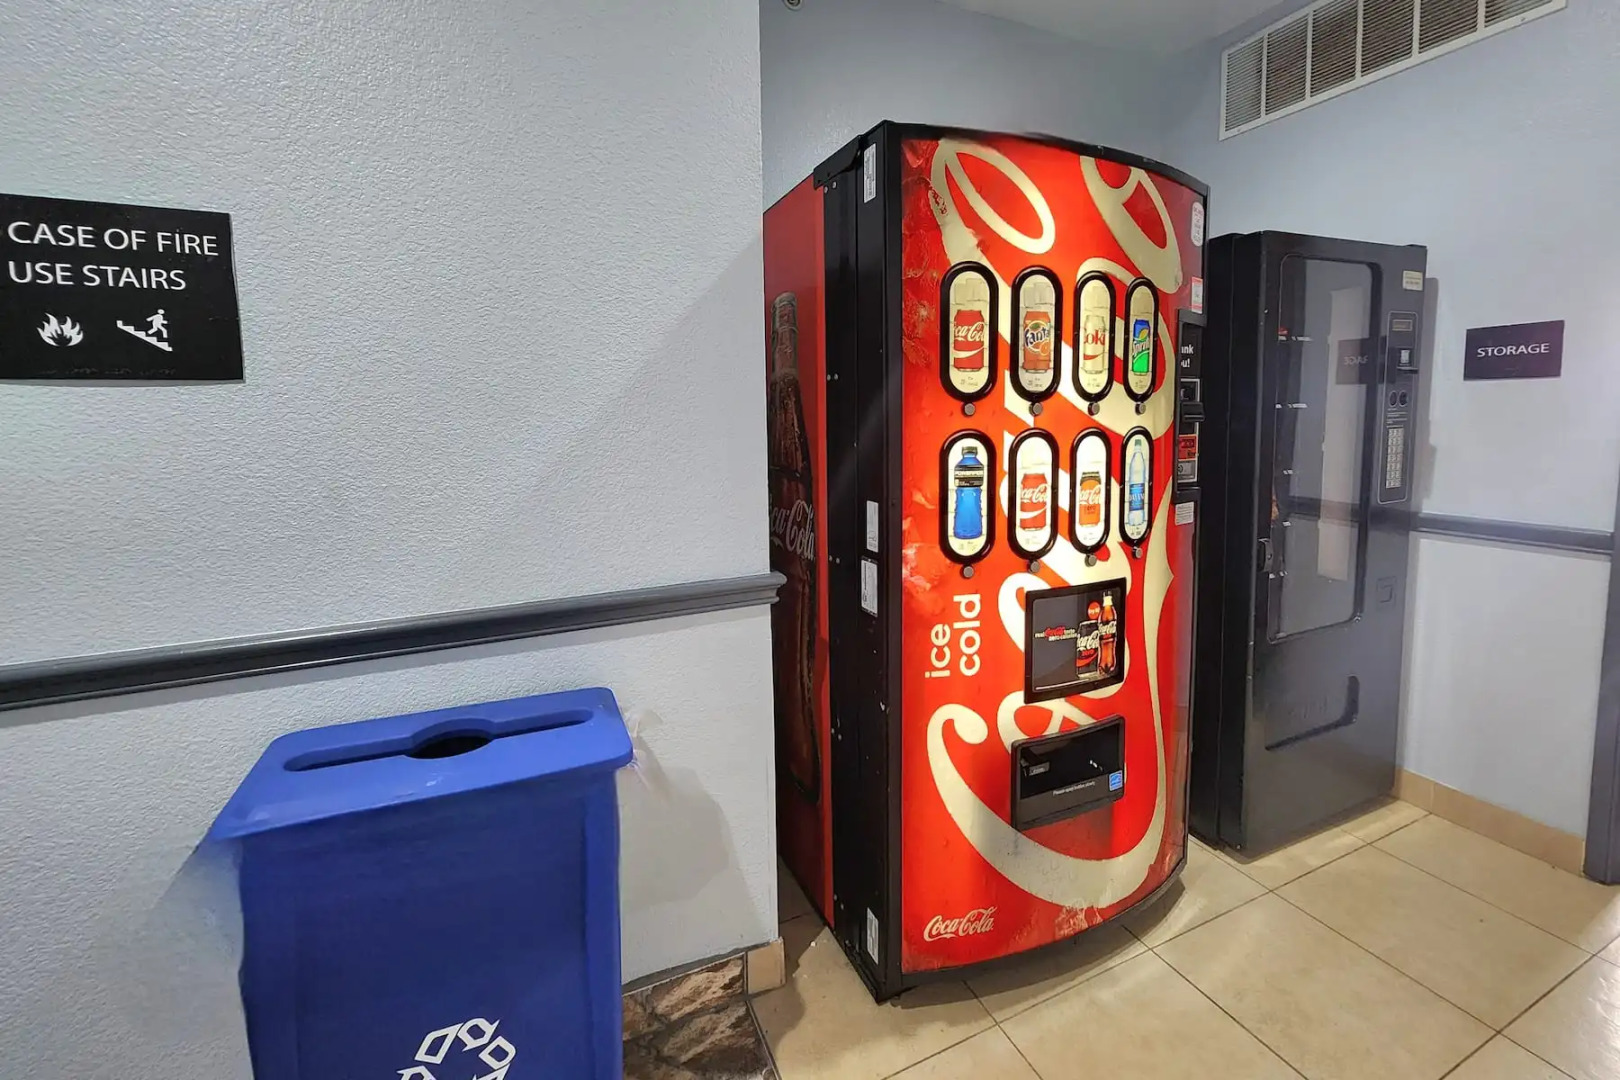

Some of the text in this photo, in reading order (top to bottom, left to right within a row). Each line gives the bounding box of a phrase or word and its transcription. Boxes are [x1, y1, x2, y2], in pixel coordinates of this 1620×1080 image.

[7, 221, 219, 256] CASE OF FIRE
[8, 260, 187, 290] USE STAIRS
[1476, 343, 1550, 358] STORAGE
[925, 623, 951, 678] ice
[953, 593, 981, 677] cold
[923, 906, 998, 942] Coca-Cola
